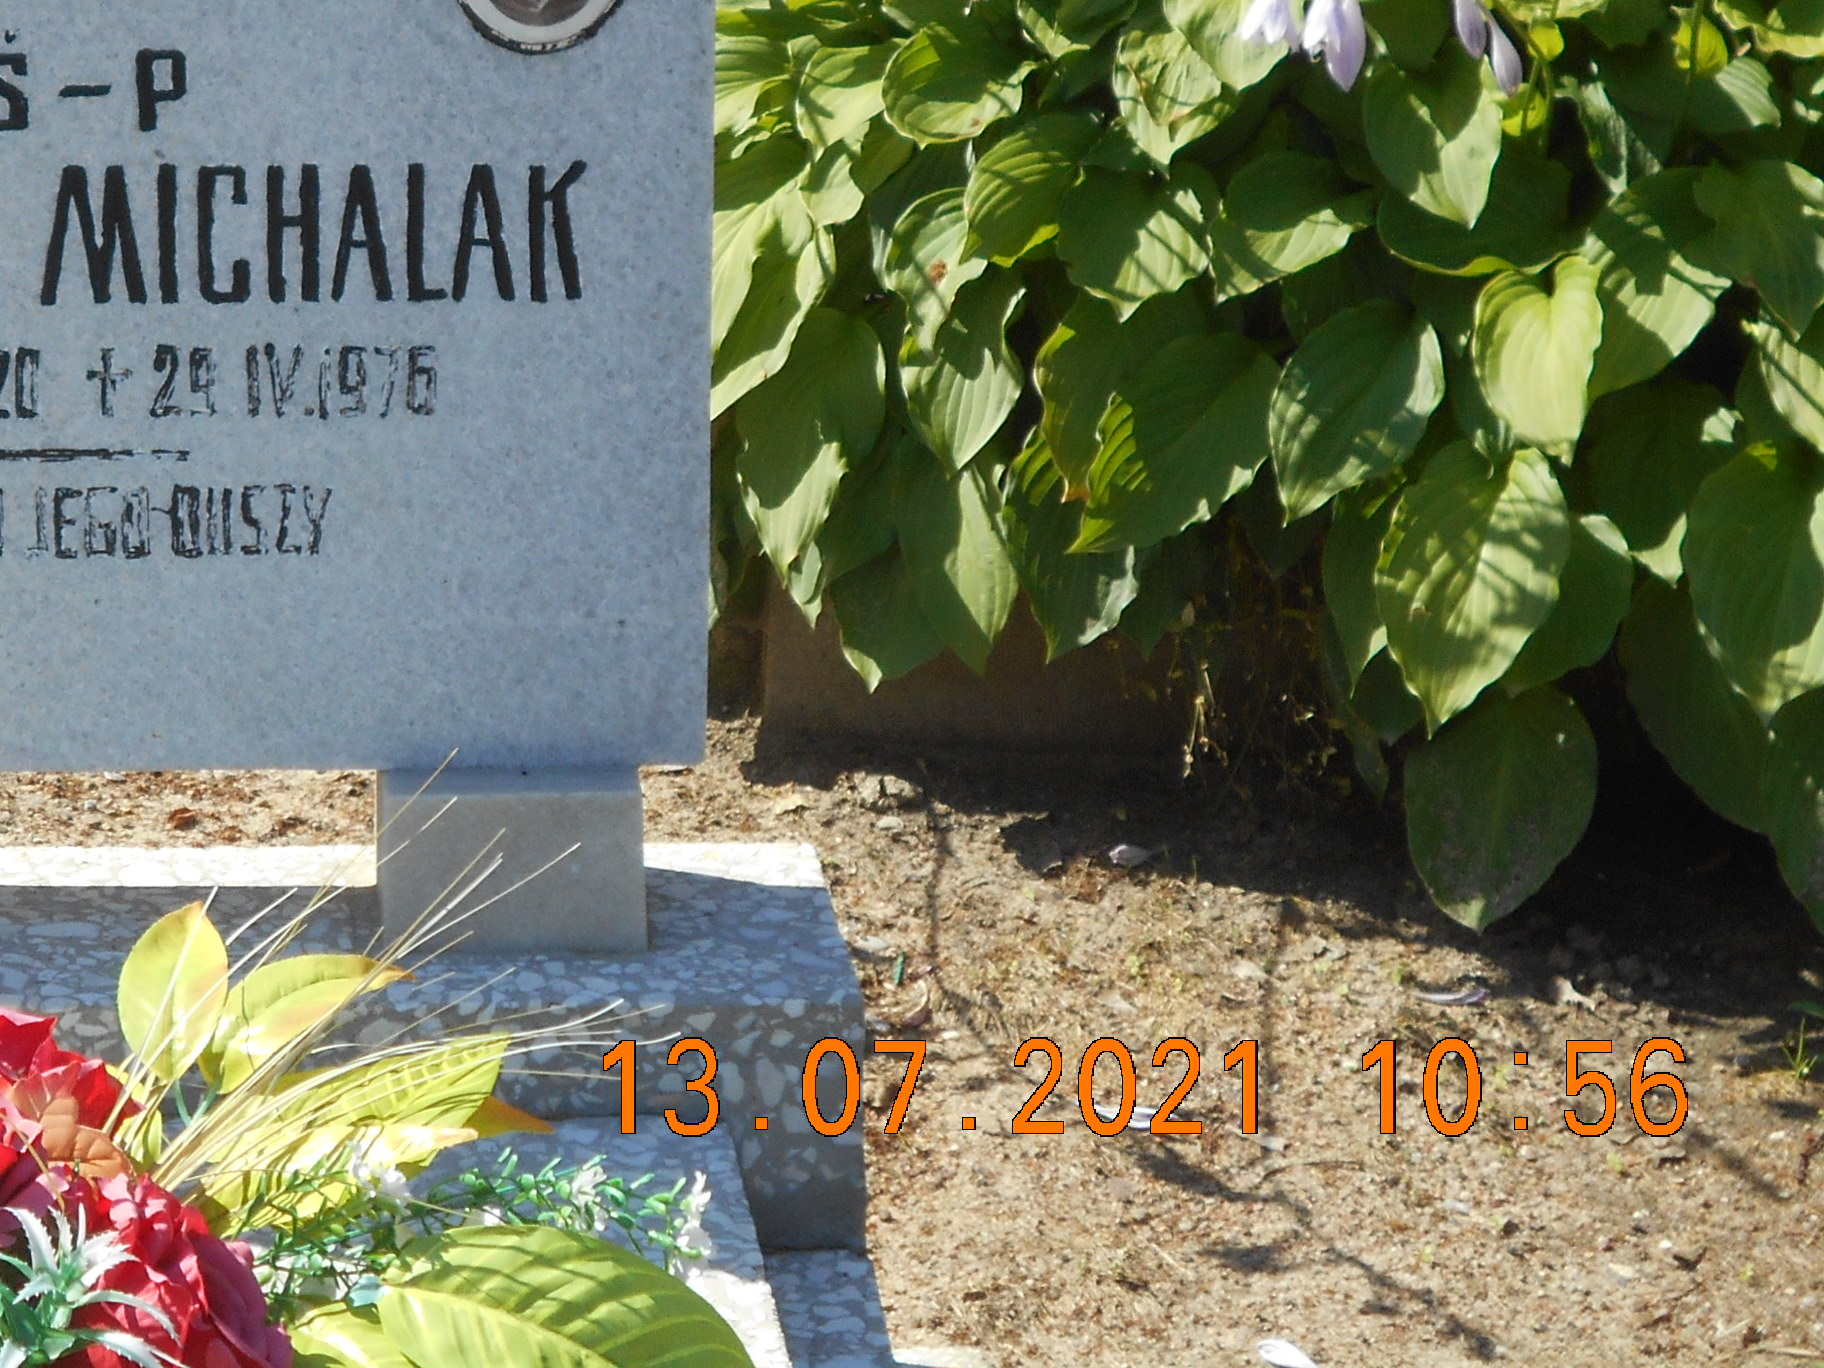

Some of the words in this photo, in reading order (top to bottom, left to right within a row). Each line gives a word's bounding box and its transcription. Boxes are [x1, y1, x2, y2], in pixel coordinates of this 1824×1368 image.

[39, 157, 590, 307] MICHALAK
[26, 485, 154, 562] JEGO
[167, 483, 334, 561] DUSZY
